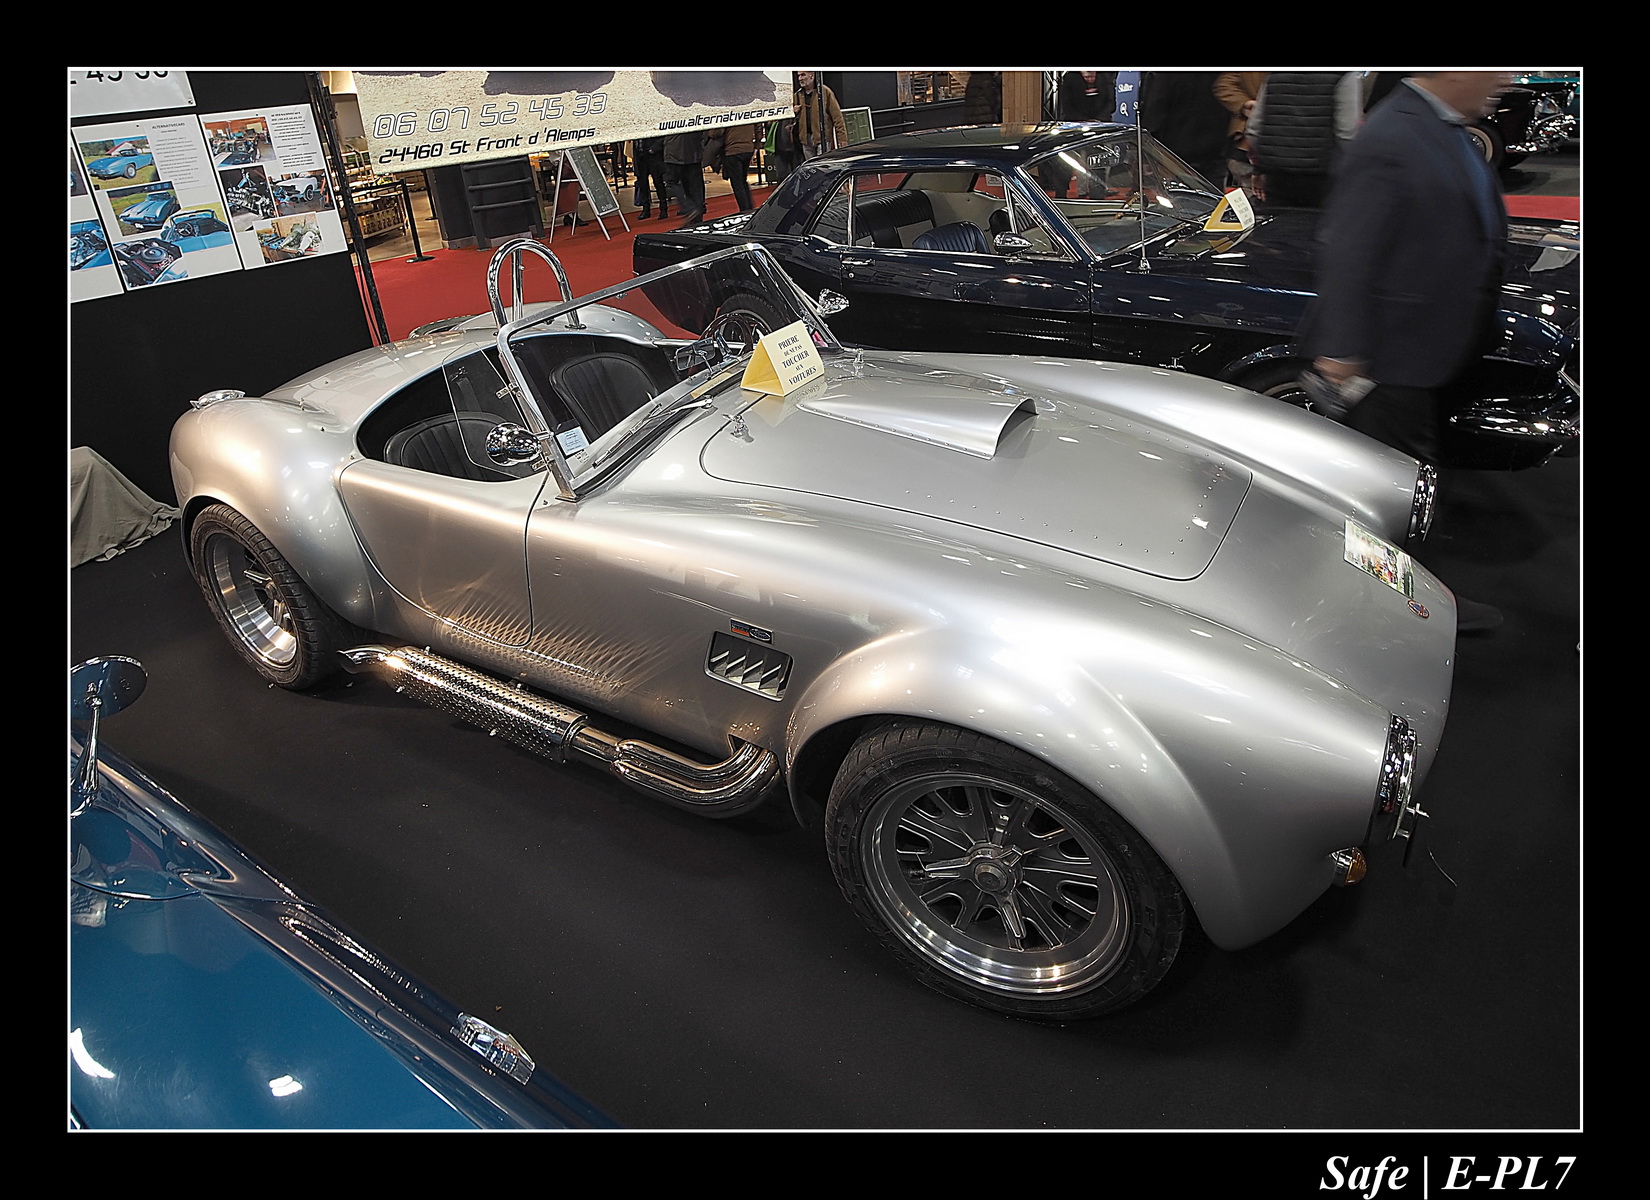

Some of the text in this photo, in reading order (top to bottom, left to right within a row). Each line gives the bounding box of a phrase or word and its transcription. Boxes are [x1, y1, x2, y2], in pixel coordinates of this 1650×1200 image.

[373, 93, 607, 139] 06 07 52 45 33
[658, 106, 789, 130] www.alternativecars.fr
[378, 142, 443, 164] 24460
[449, 140, 471, 156] St
[476, 134, 523, 151] Front
[782, 350, 810, 369] TOUCHER
[788, 366, 817, 385] VOITURES
